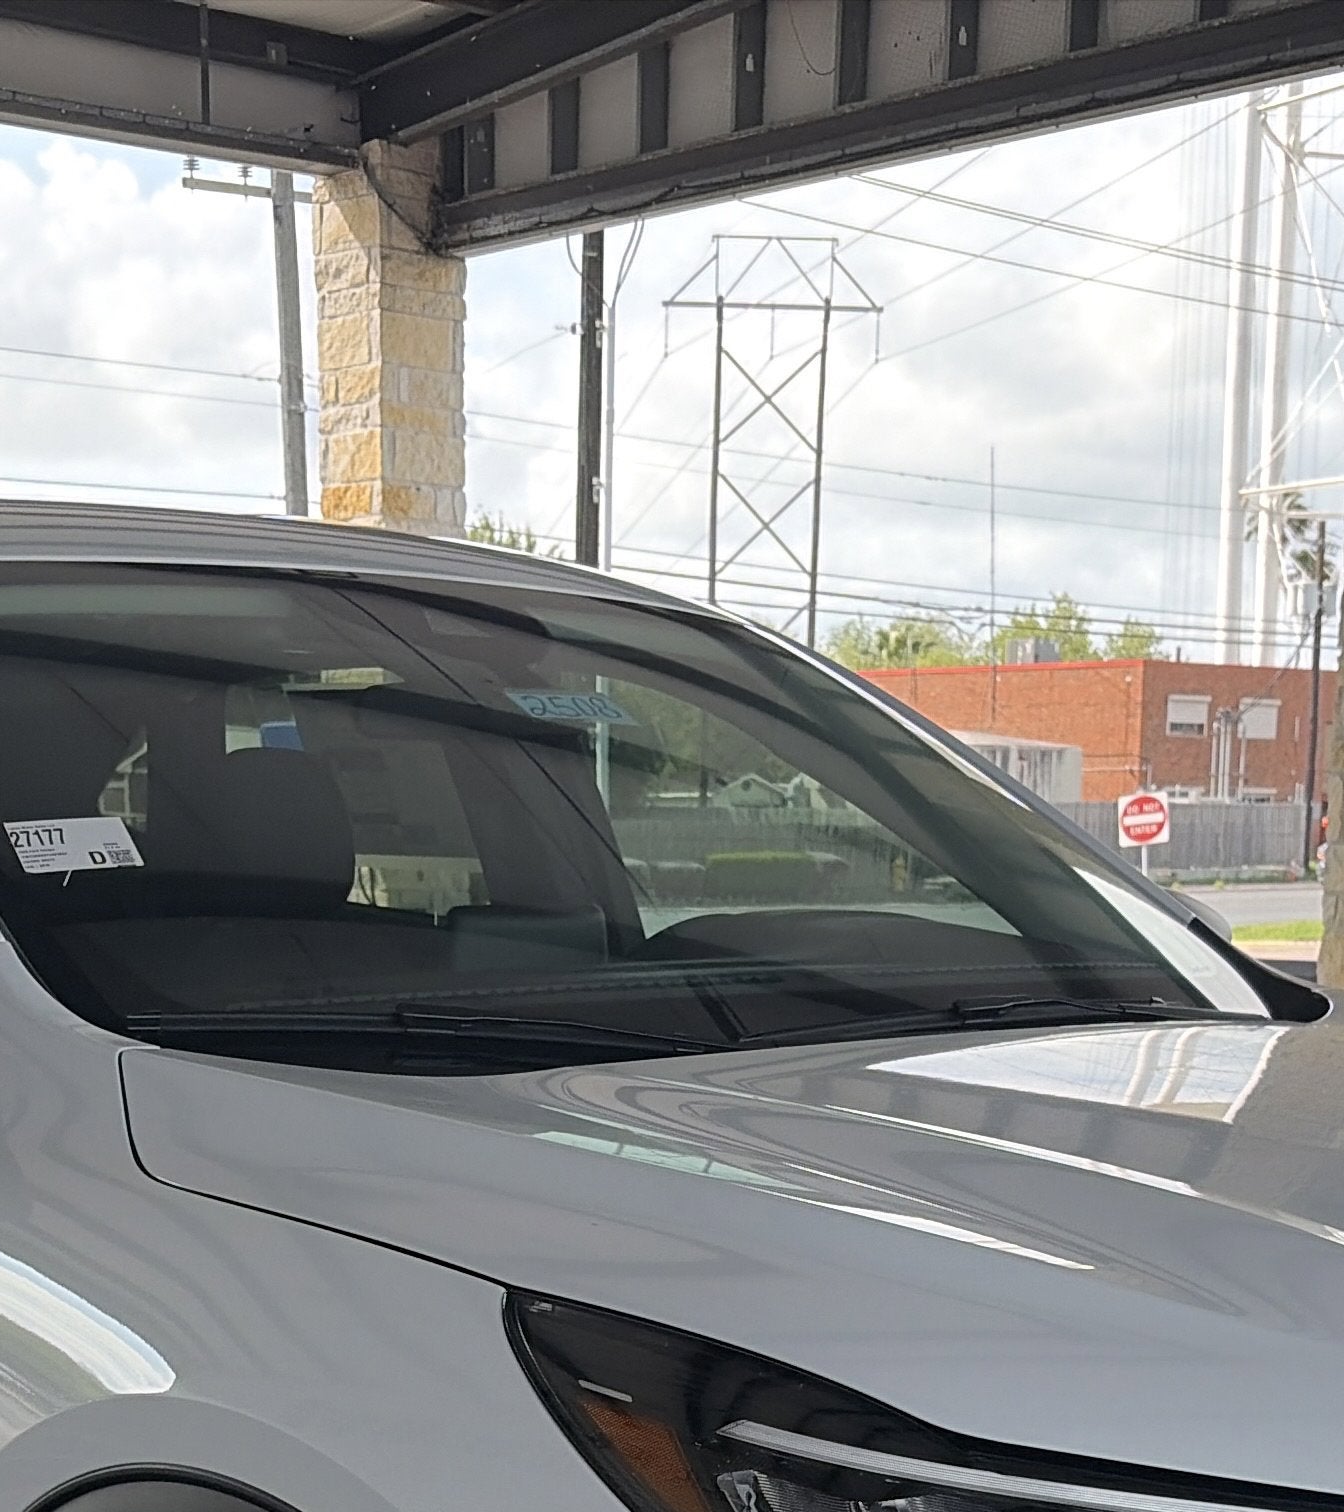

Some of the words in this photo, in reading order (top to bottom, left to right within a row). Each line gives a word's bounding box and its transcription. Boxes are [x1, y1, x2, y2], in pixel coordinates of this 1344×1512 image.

[520, 695, 623, 718] 2508
[1126, 804, 1141, 815] DO
[1142, 802, 1161, 812] NOT
[9, 828, 65, 848] 27177
[1129, 825, 1158, 836] ENTER
[88, 850, 107, 865] D
